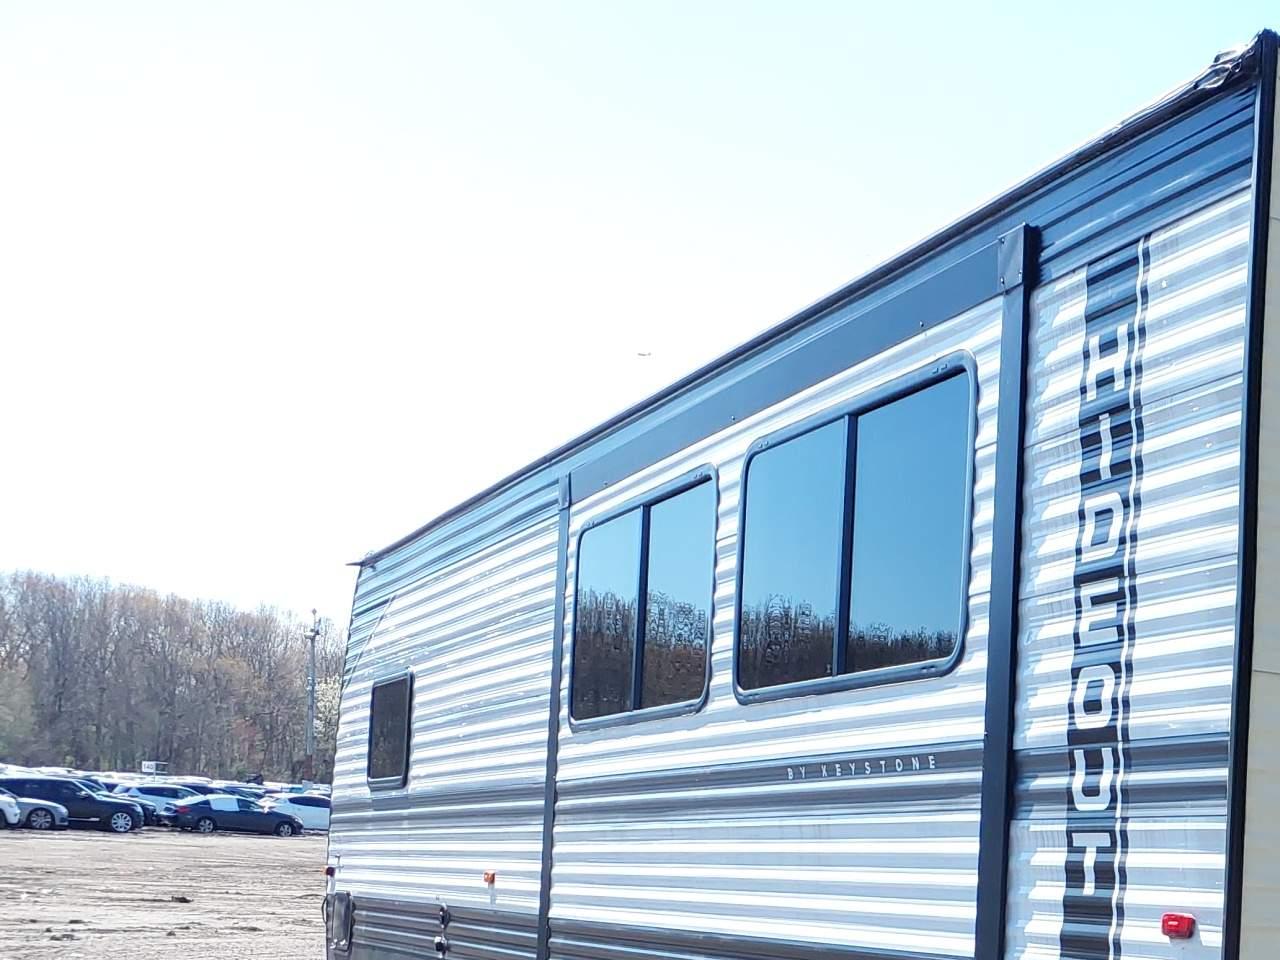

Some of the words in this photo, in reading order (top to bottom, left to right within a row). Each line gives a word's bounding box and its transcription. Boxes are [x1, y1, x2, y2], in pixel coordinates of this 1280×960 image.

[1072, 322, 1129, 896] HIDEOUT
[787, 766, 807, 780] BY
[820, 755, 936, 778] KEYSTONE
